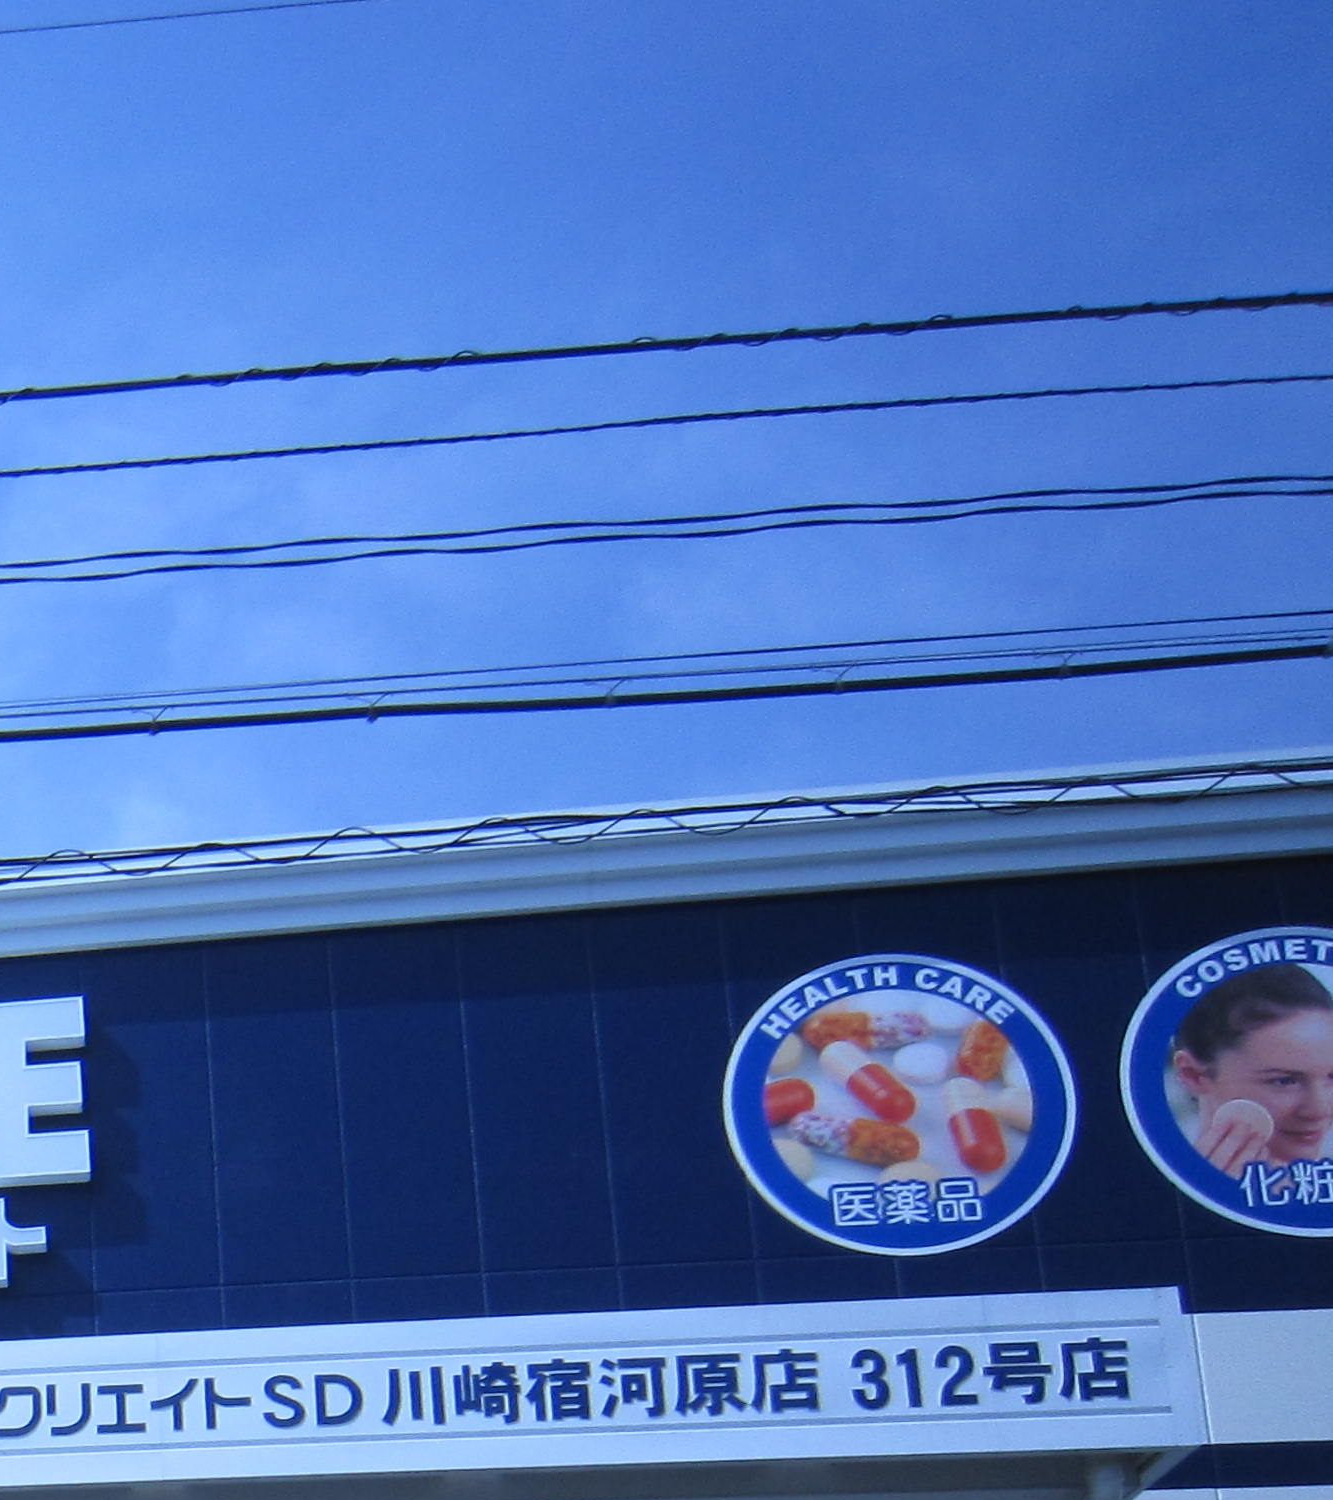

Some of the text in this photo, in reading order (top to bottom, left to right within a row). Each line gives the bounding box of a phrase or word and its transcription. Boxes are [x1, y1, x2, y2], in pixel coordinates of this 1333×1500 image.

[1175, 938, 1333, 998] COSMET
[759, 964, 1015, 1040] HEALTH CARE
[831, 1178, 984, 1228] 医薬品
[851, 1336, 1132, 1411] 312号店
